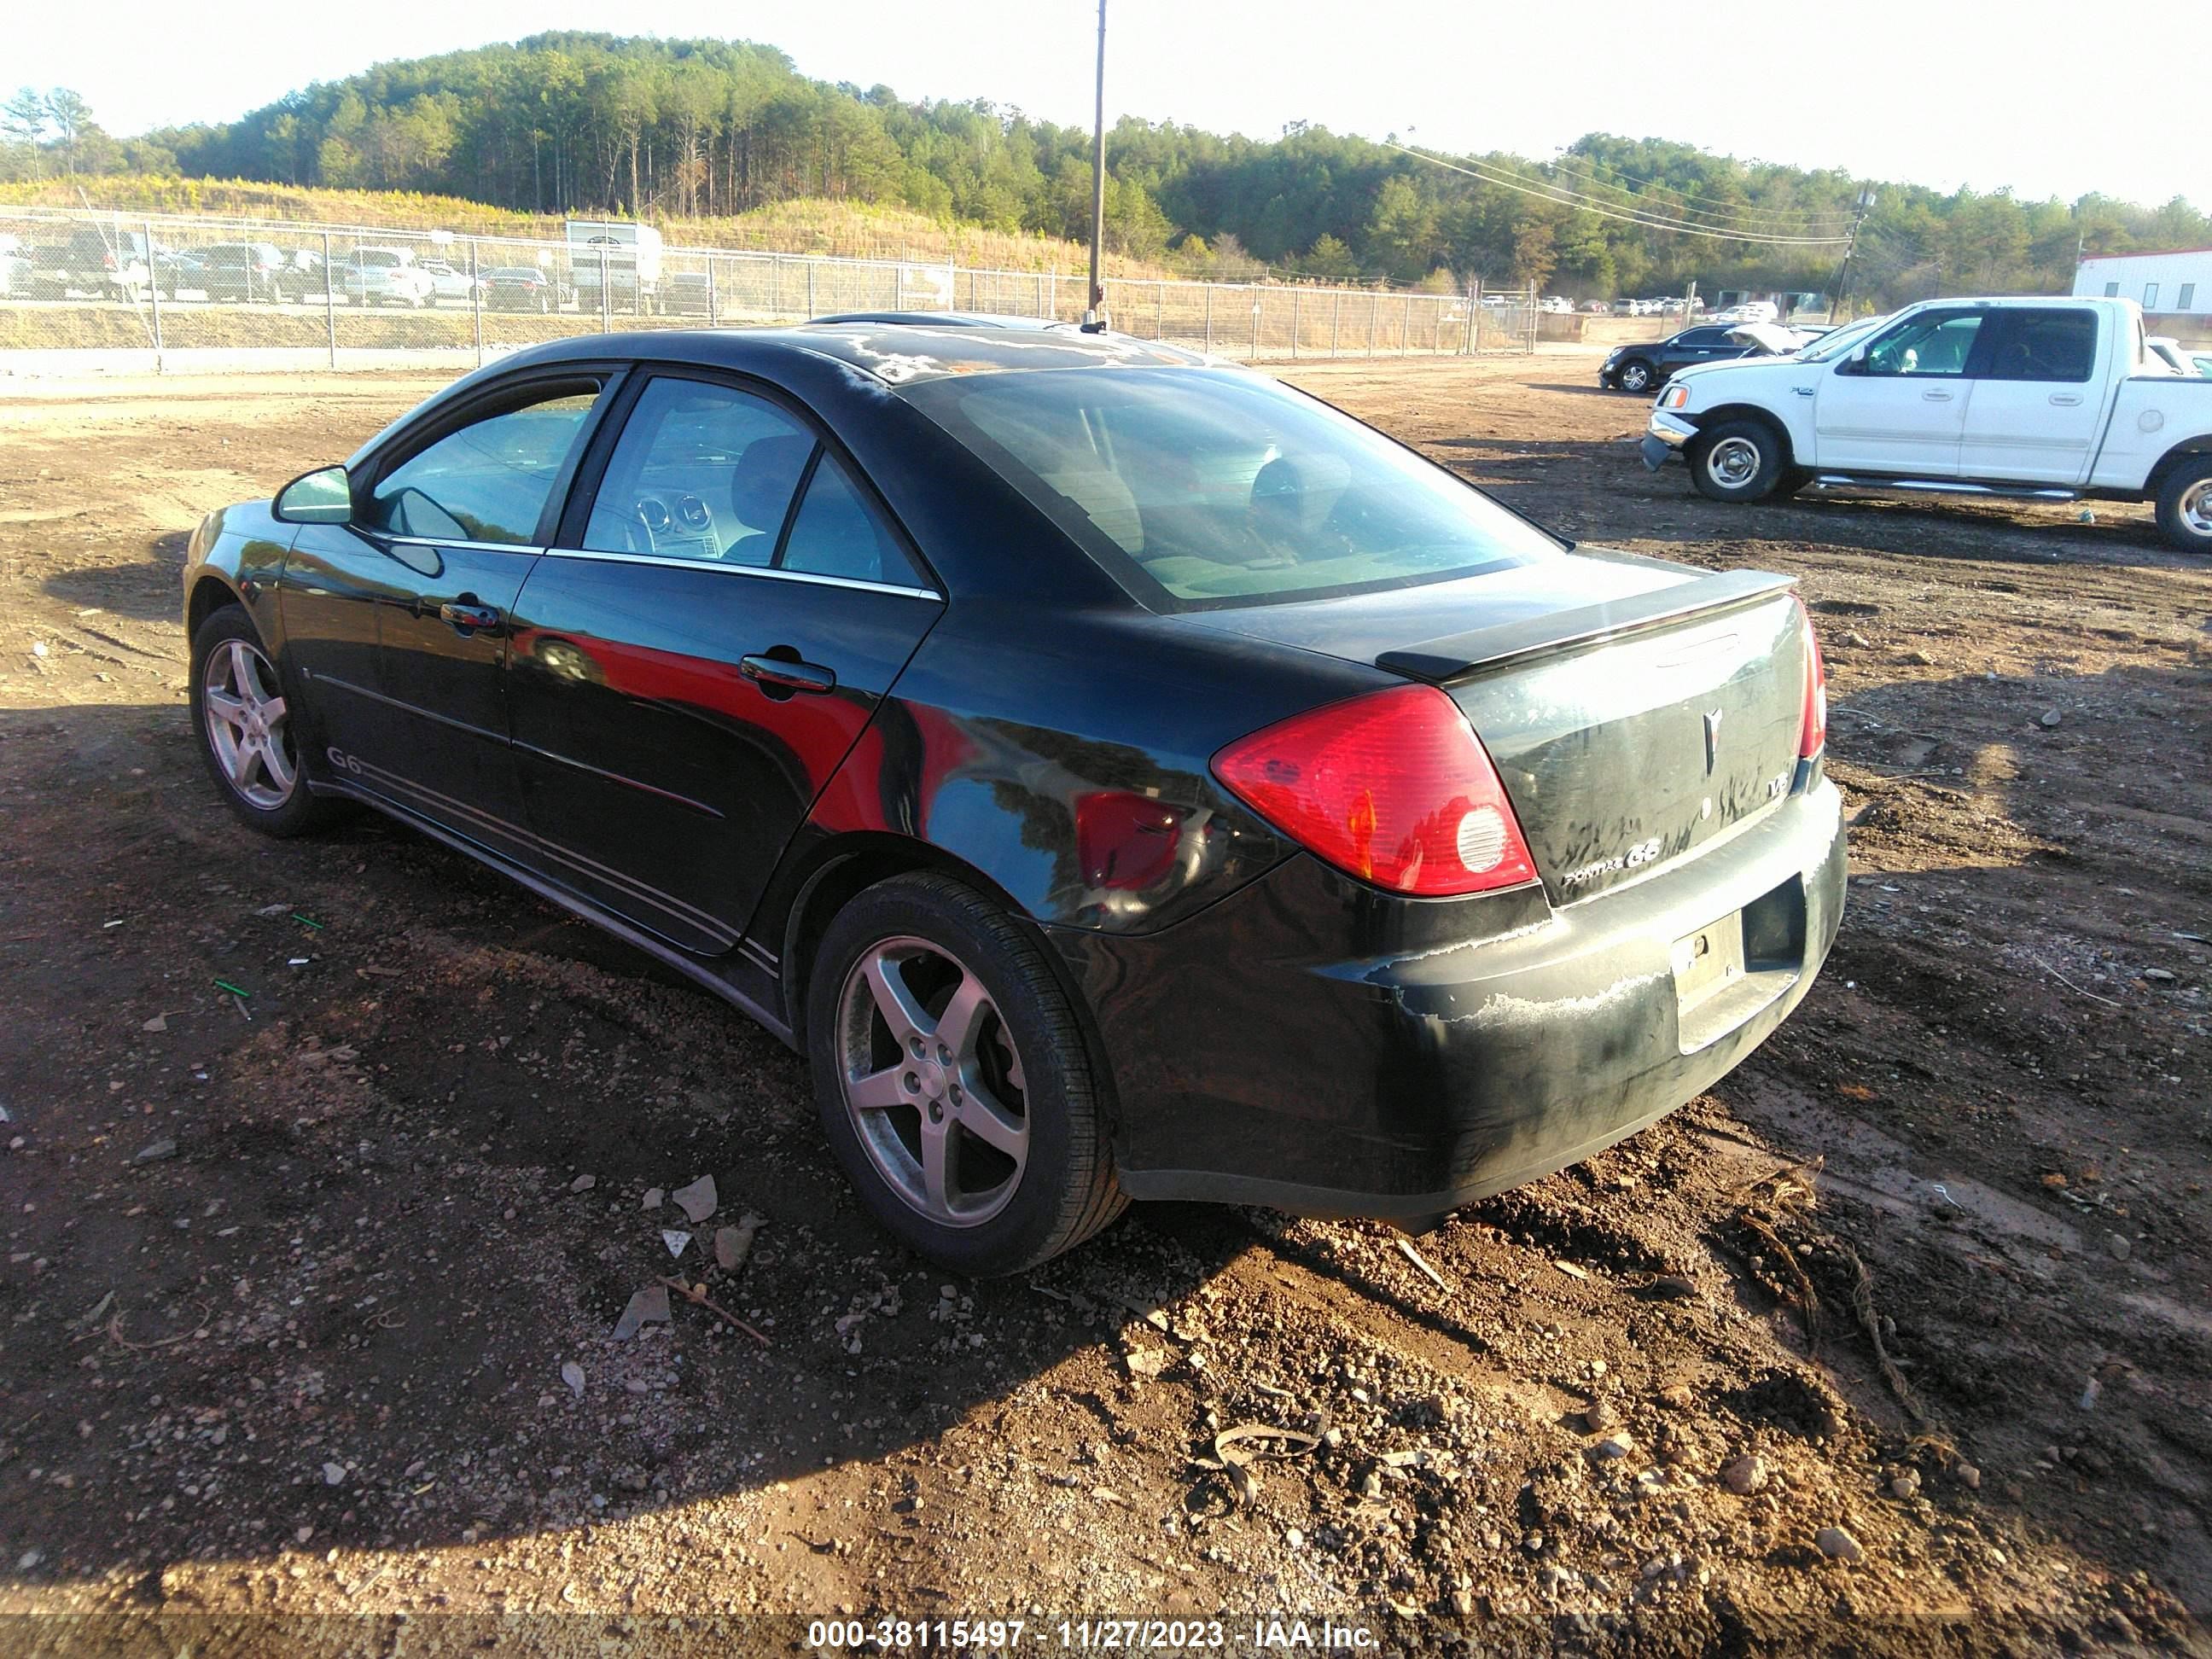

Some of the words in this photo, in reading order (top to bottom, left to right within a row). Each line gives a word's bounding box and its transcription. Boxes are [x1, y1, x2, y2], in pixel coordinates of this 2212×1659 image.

[327, 747, 361, 774] G6
[1767, 772, 1789, 797] V6
[1623, 838, 1662, 869] G6
